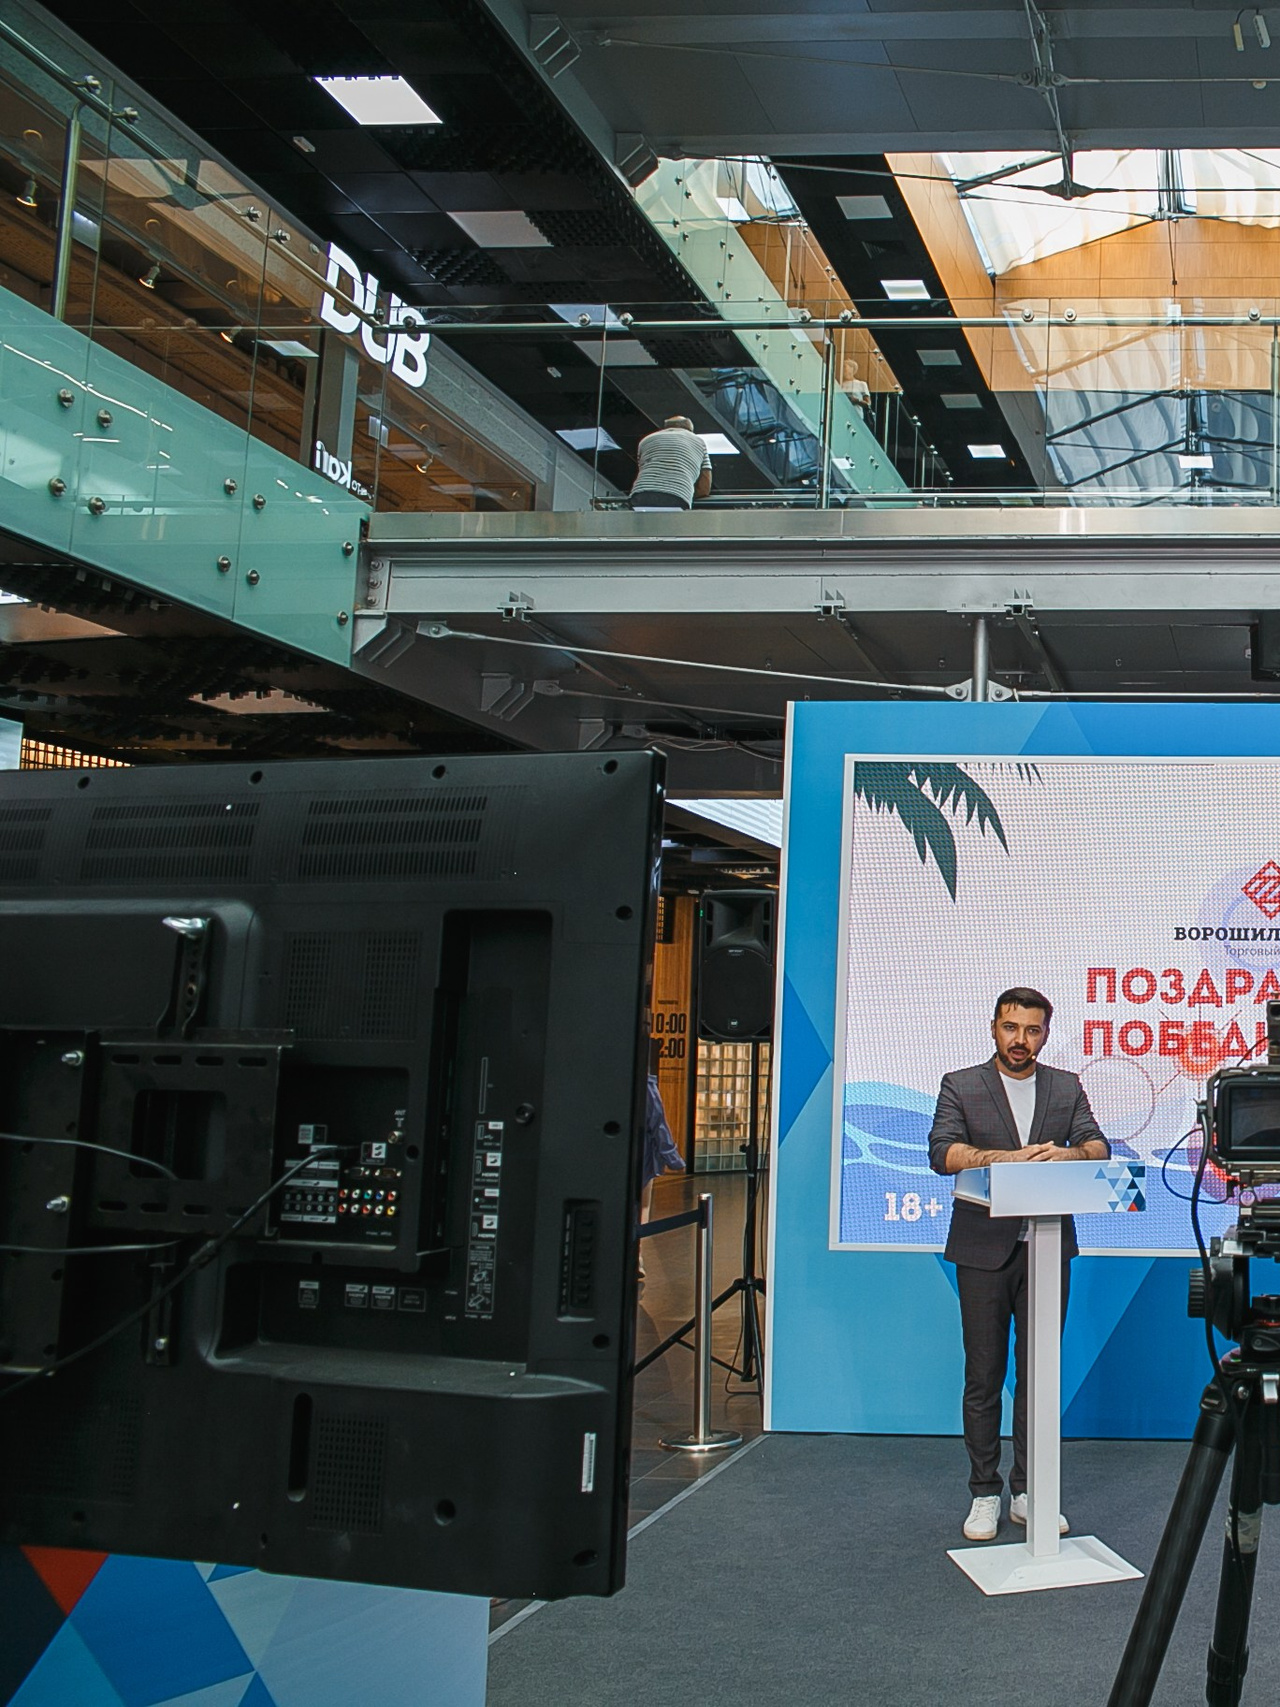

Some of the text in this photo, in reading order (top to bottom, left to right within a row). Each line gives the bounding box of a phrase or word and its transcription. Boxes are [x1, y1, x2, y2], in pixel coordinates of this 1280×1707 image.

[320, 241, 430, 388] DUB
[1224, 944, 1280, 958] Торговый
[659, 1038, 686, 1059] 2:00
[884, 1192, 944, 1222] 18+
